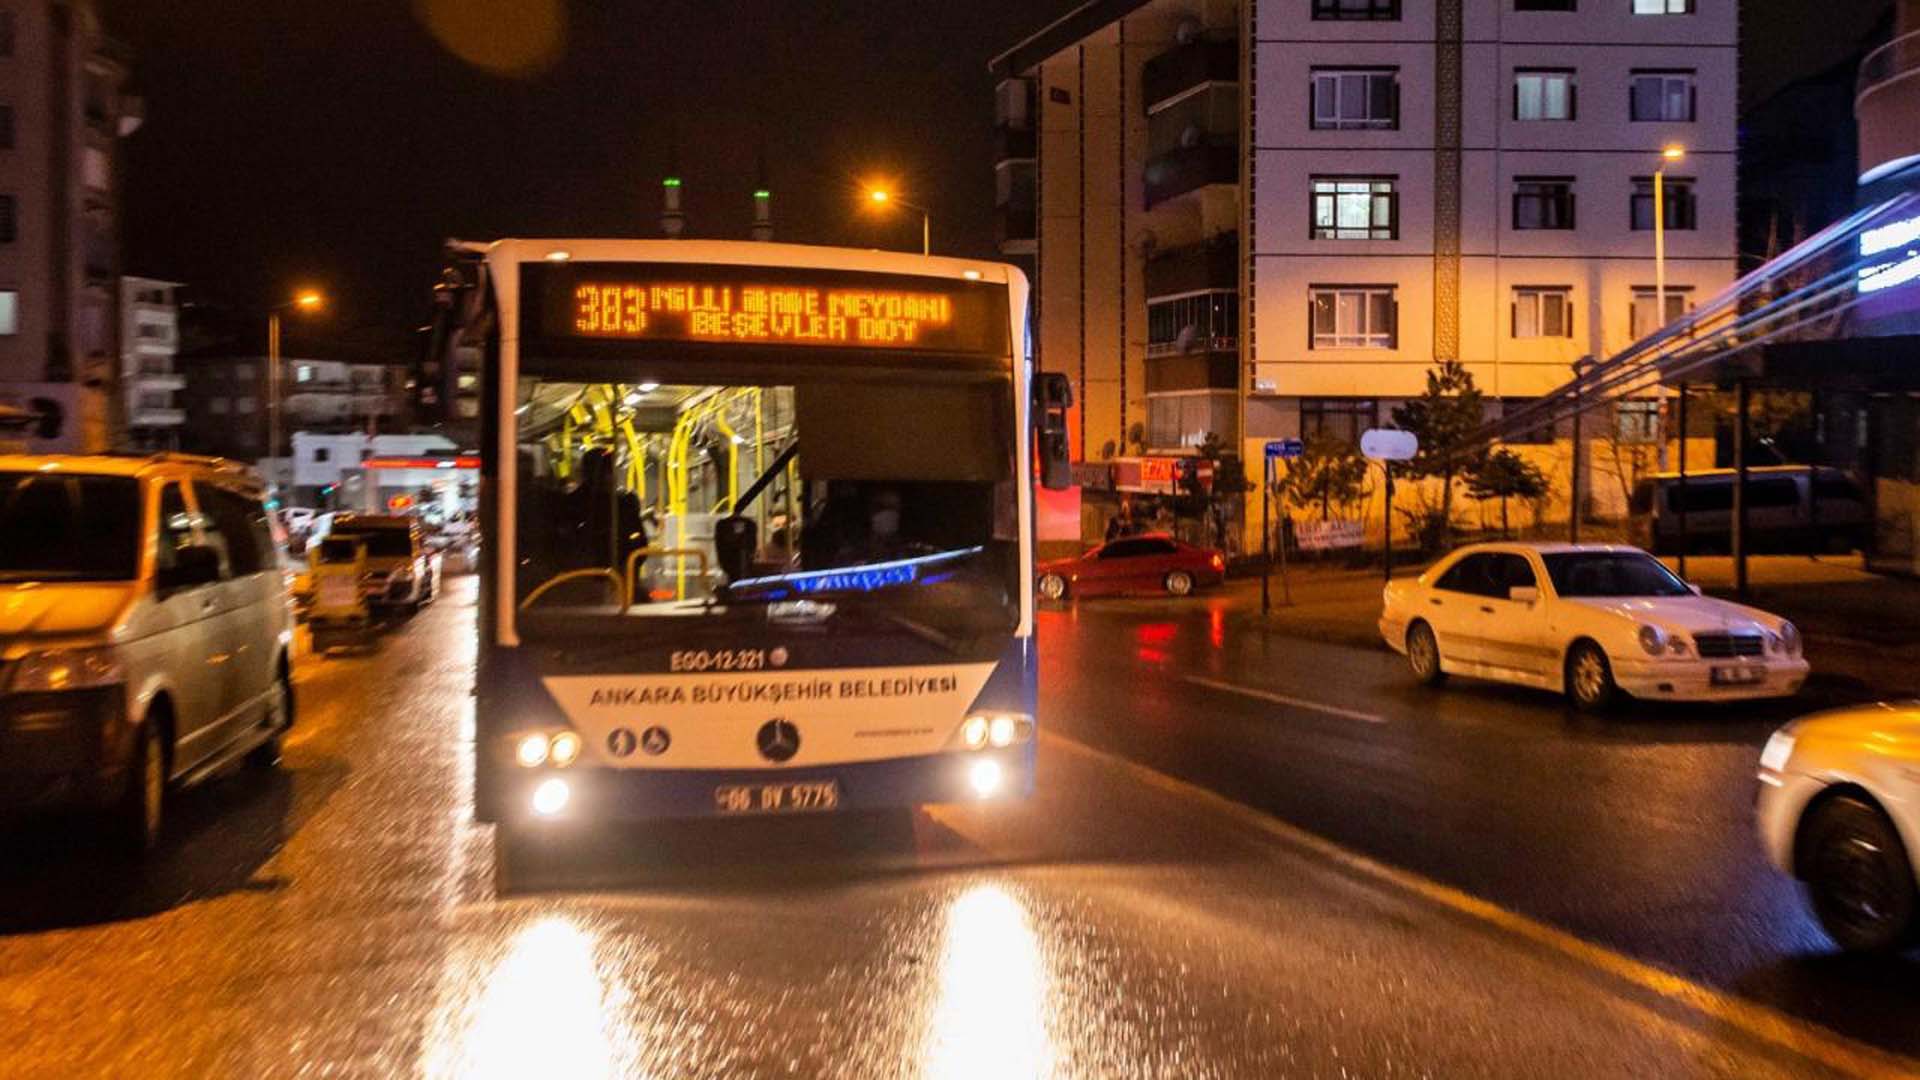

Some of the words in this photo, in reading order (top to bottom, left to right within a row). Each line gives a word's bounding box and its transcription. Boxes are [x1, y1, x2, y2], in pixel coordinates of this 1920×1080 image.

[576, 287, 647, 332] 303
[590, 687, 685, 705] ANKARA
[692, 678, 833, 704] BÜYÜKŞEHİR
[839, 673, 957, 698] BELEDİYESİ
